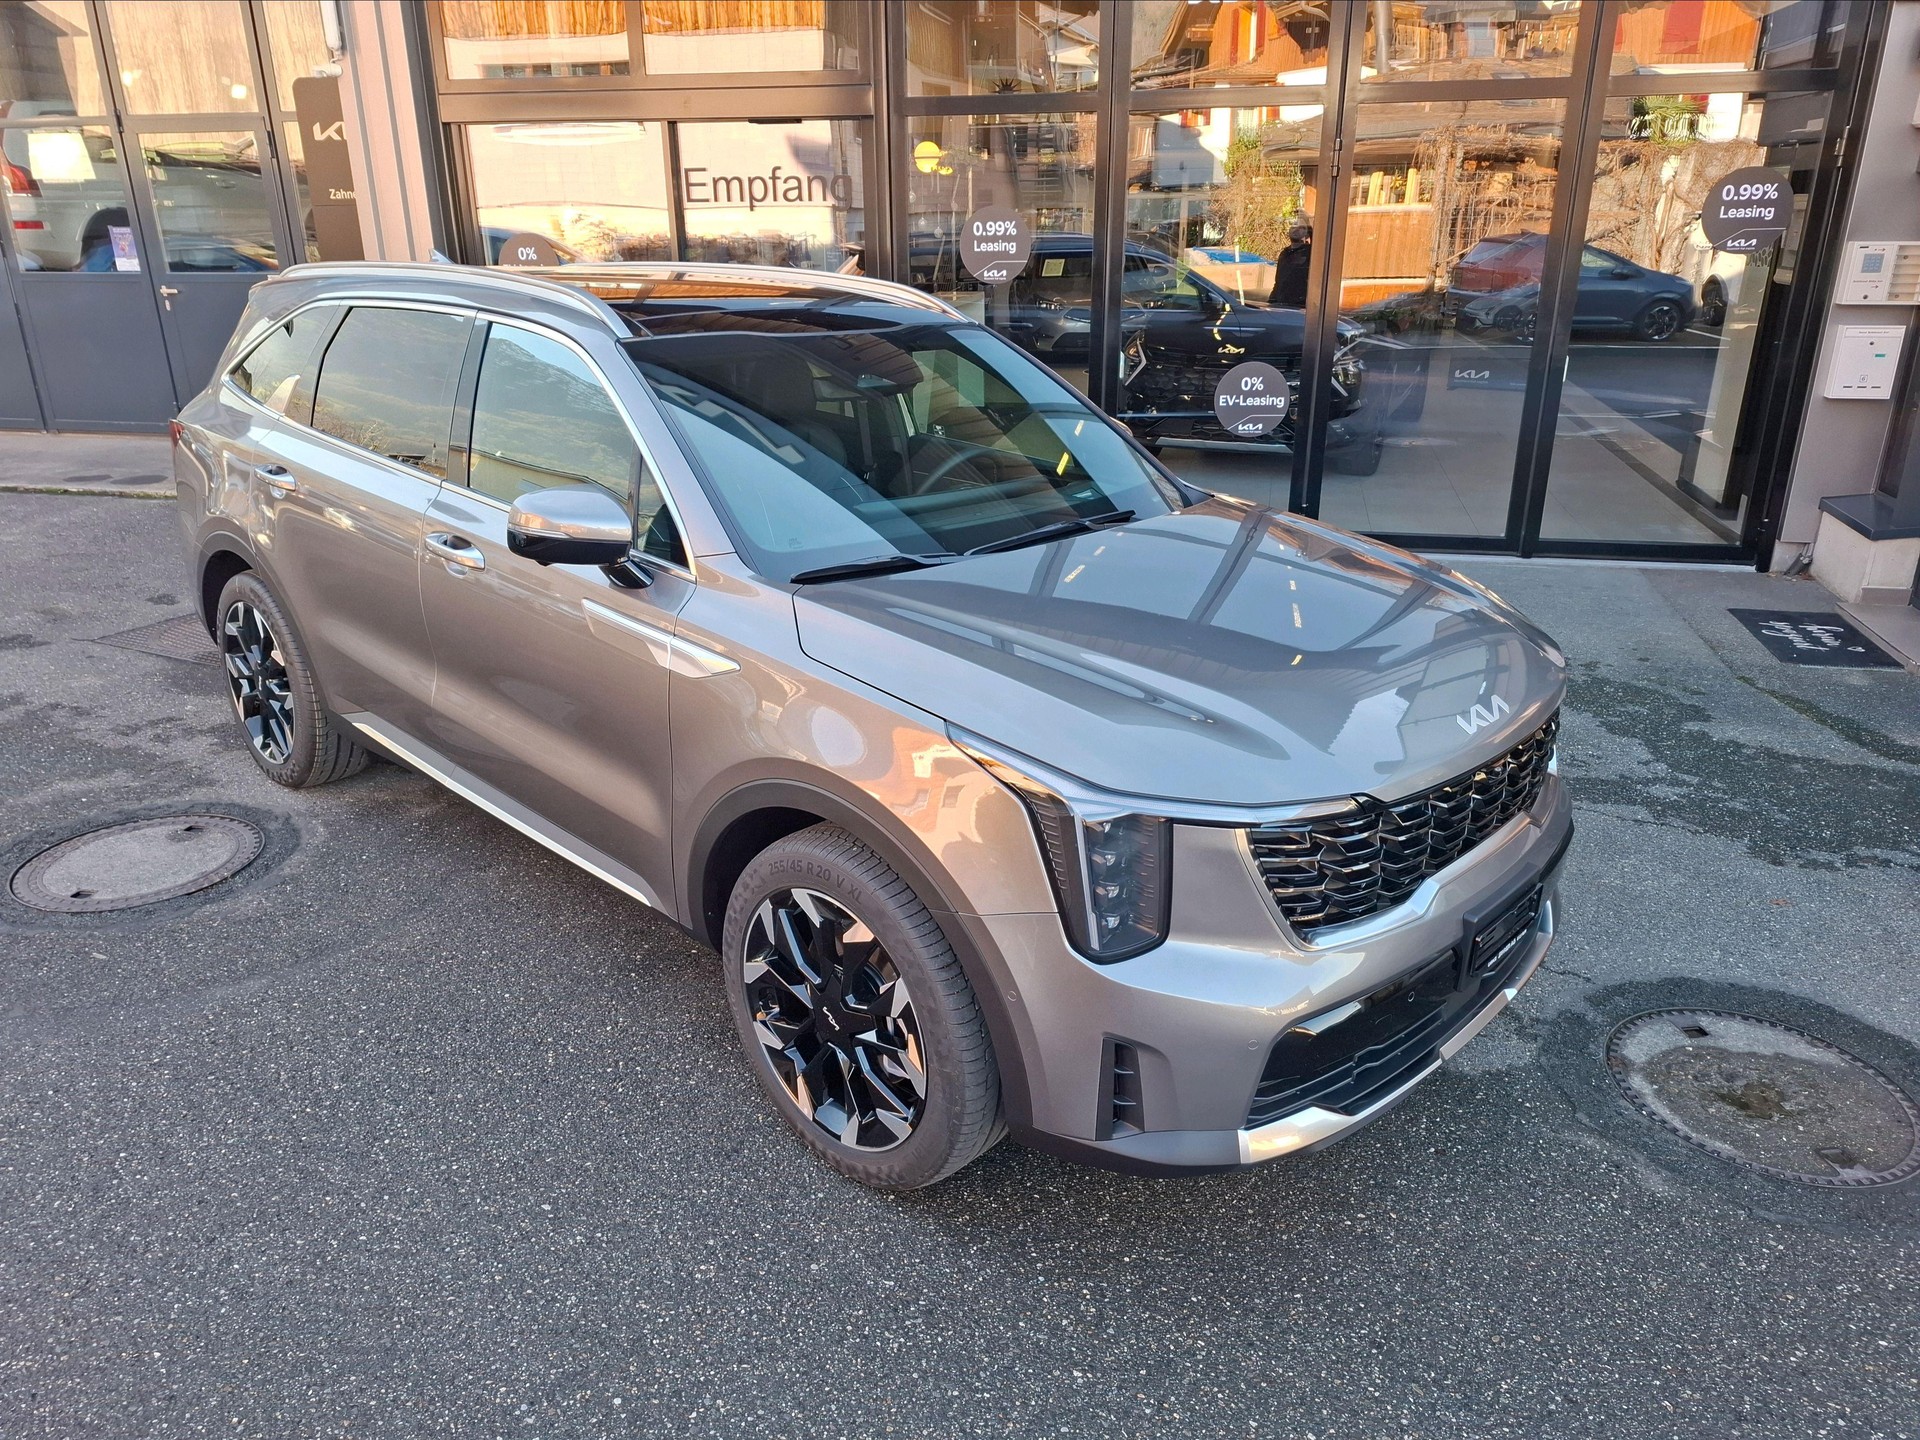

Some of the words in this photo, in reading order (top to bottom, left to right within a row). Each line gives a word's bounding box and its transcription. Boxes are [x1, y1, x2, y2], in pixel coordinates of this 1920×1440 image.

[684, 166, 852, 212] Empfang
[1722, 183, 1779, 201] 0.99%
[1720, 205, 1775, 220] Leasing
[973, 221, 1017, 236] 0.99%
[518, 247, 537, 260] 0%
[973, 240, 1017, 254] Leasing
[1241, 377, 1264, 391] 0%
[1219, 395, 1285, 408] EV-Leasing
[1456, 694, 1510, 735] KIA
[768, 859, 803, 875] 255/45
